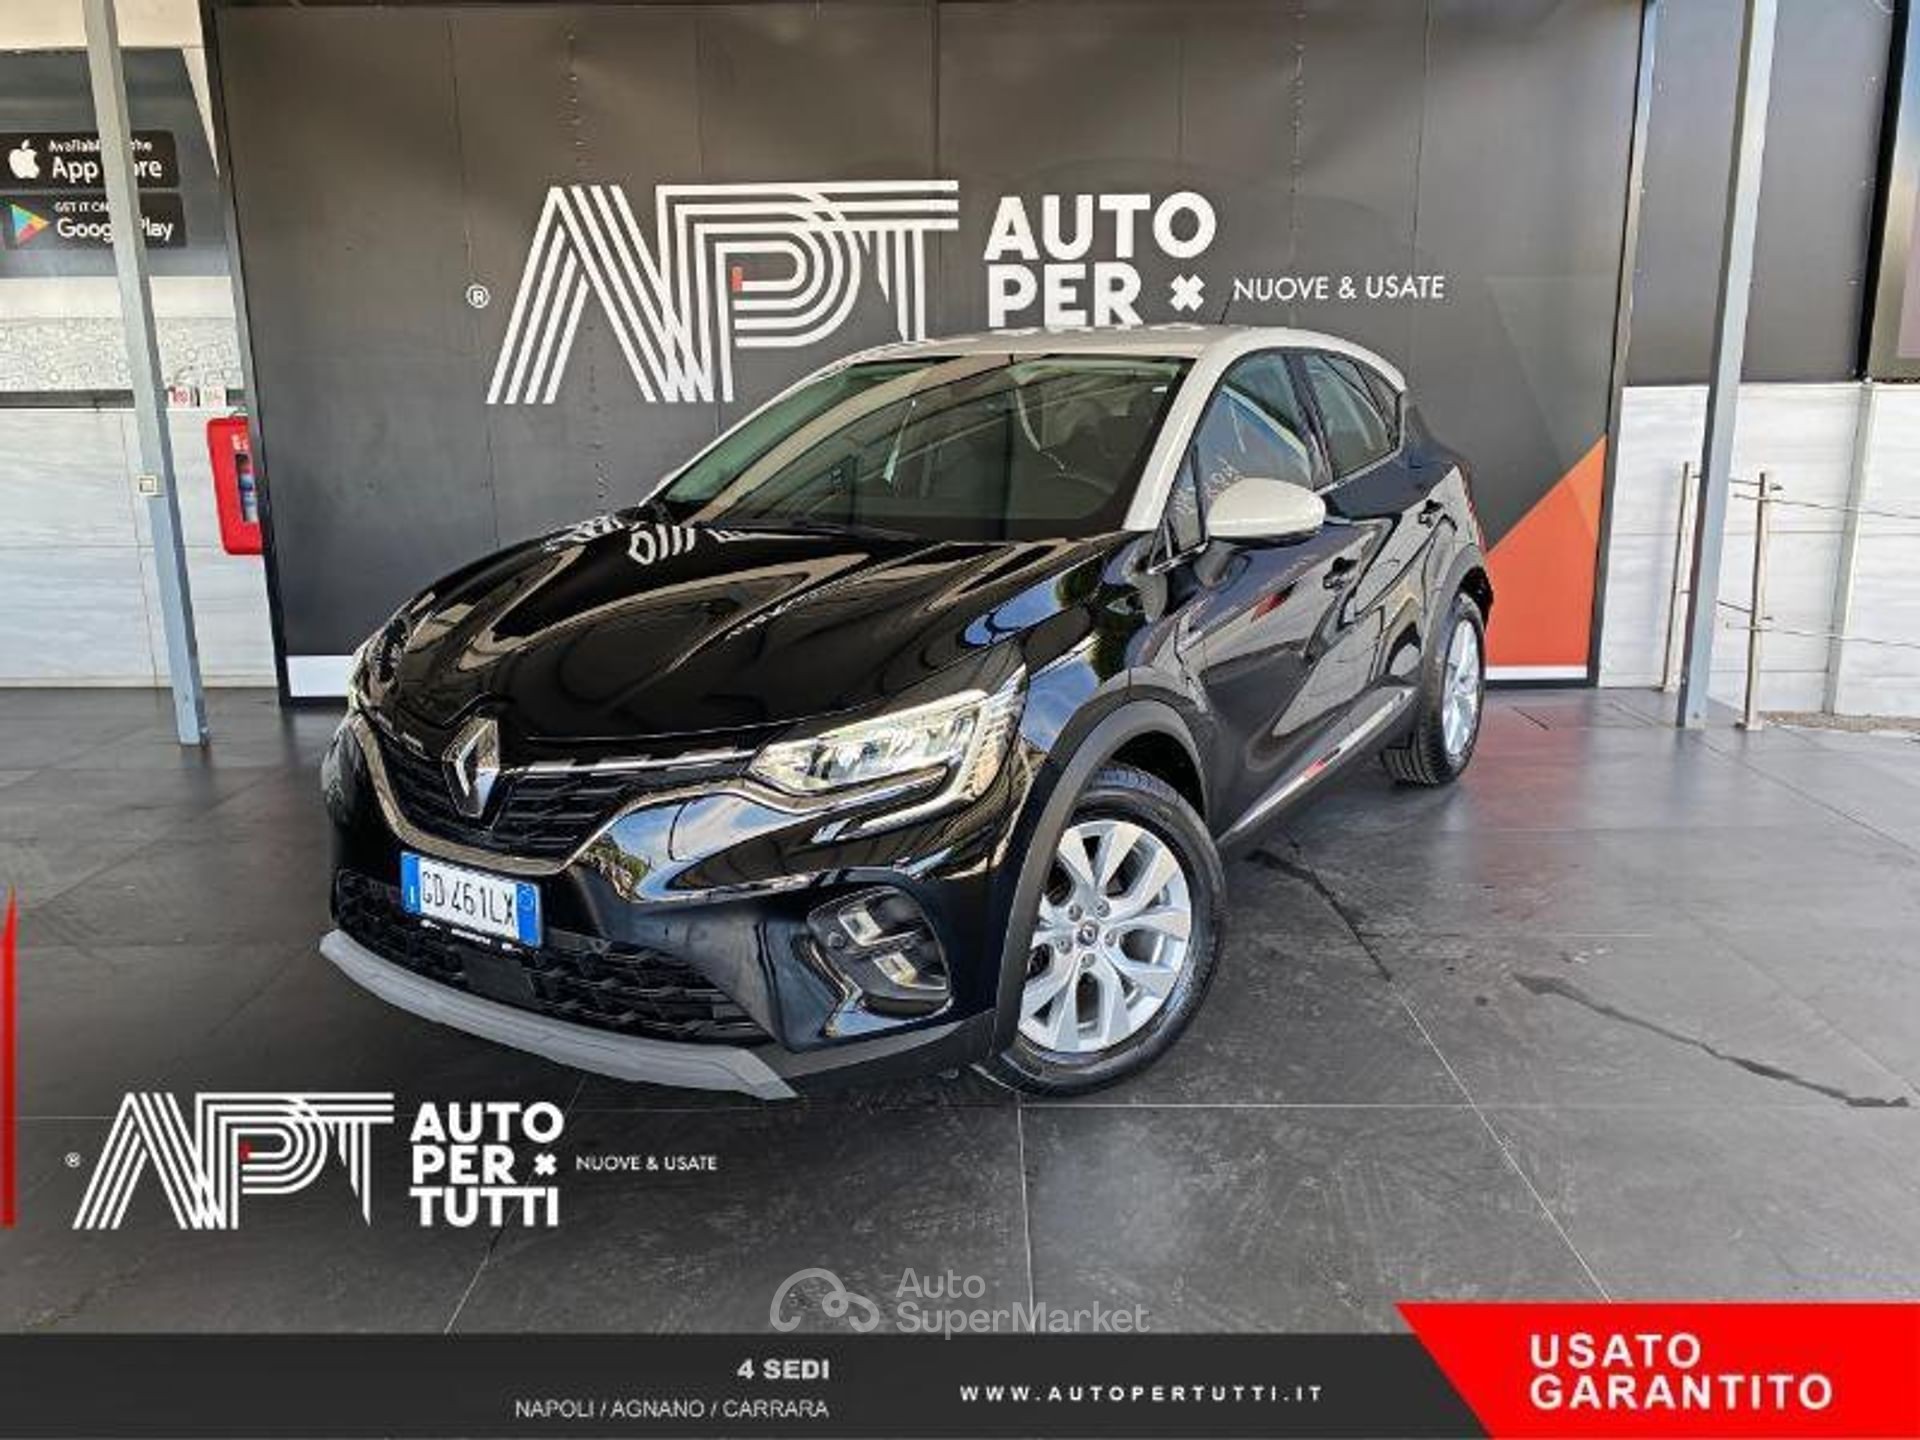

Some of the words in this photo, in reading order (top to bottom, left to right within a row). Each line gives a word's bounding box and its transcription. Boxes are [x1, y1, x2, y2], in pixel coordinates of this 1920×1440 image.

[52, 156, 99, 184] App
[57, 217, 114, 243] Goog
[984, 192, 1216, 260] AUTO
[987, 262, 1144, 328] PER
[1234, 276, 1328, 301] NUOVE
[1338, 276, 1357, 299] &
[1366, 275, 1445, 299] USATE
